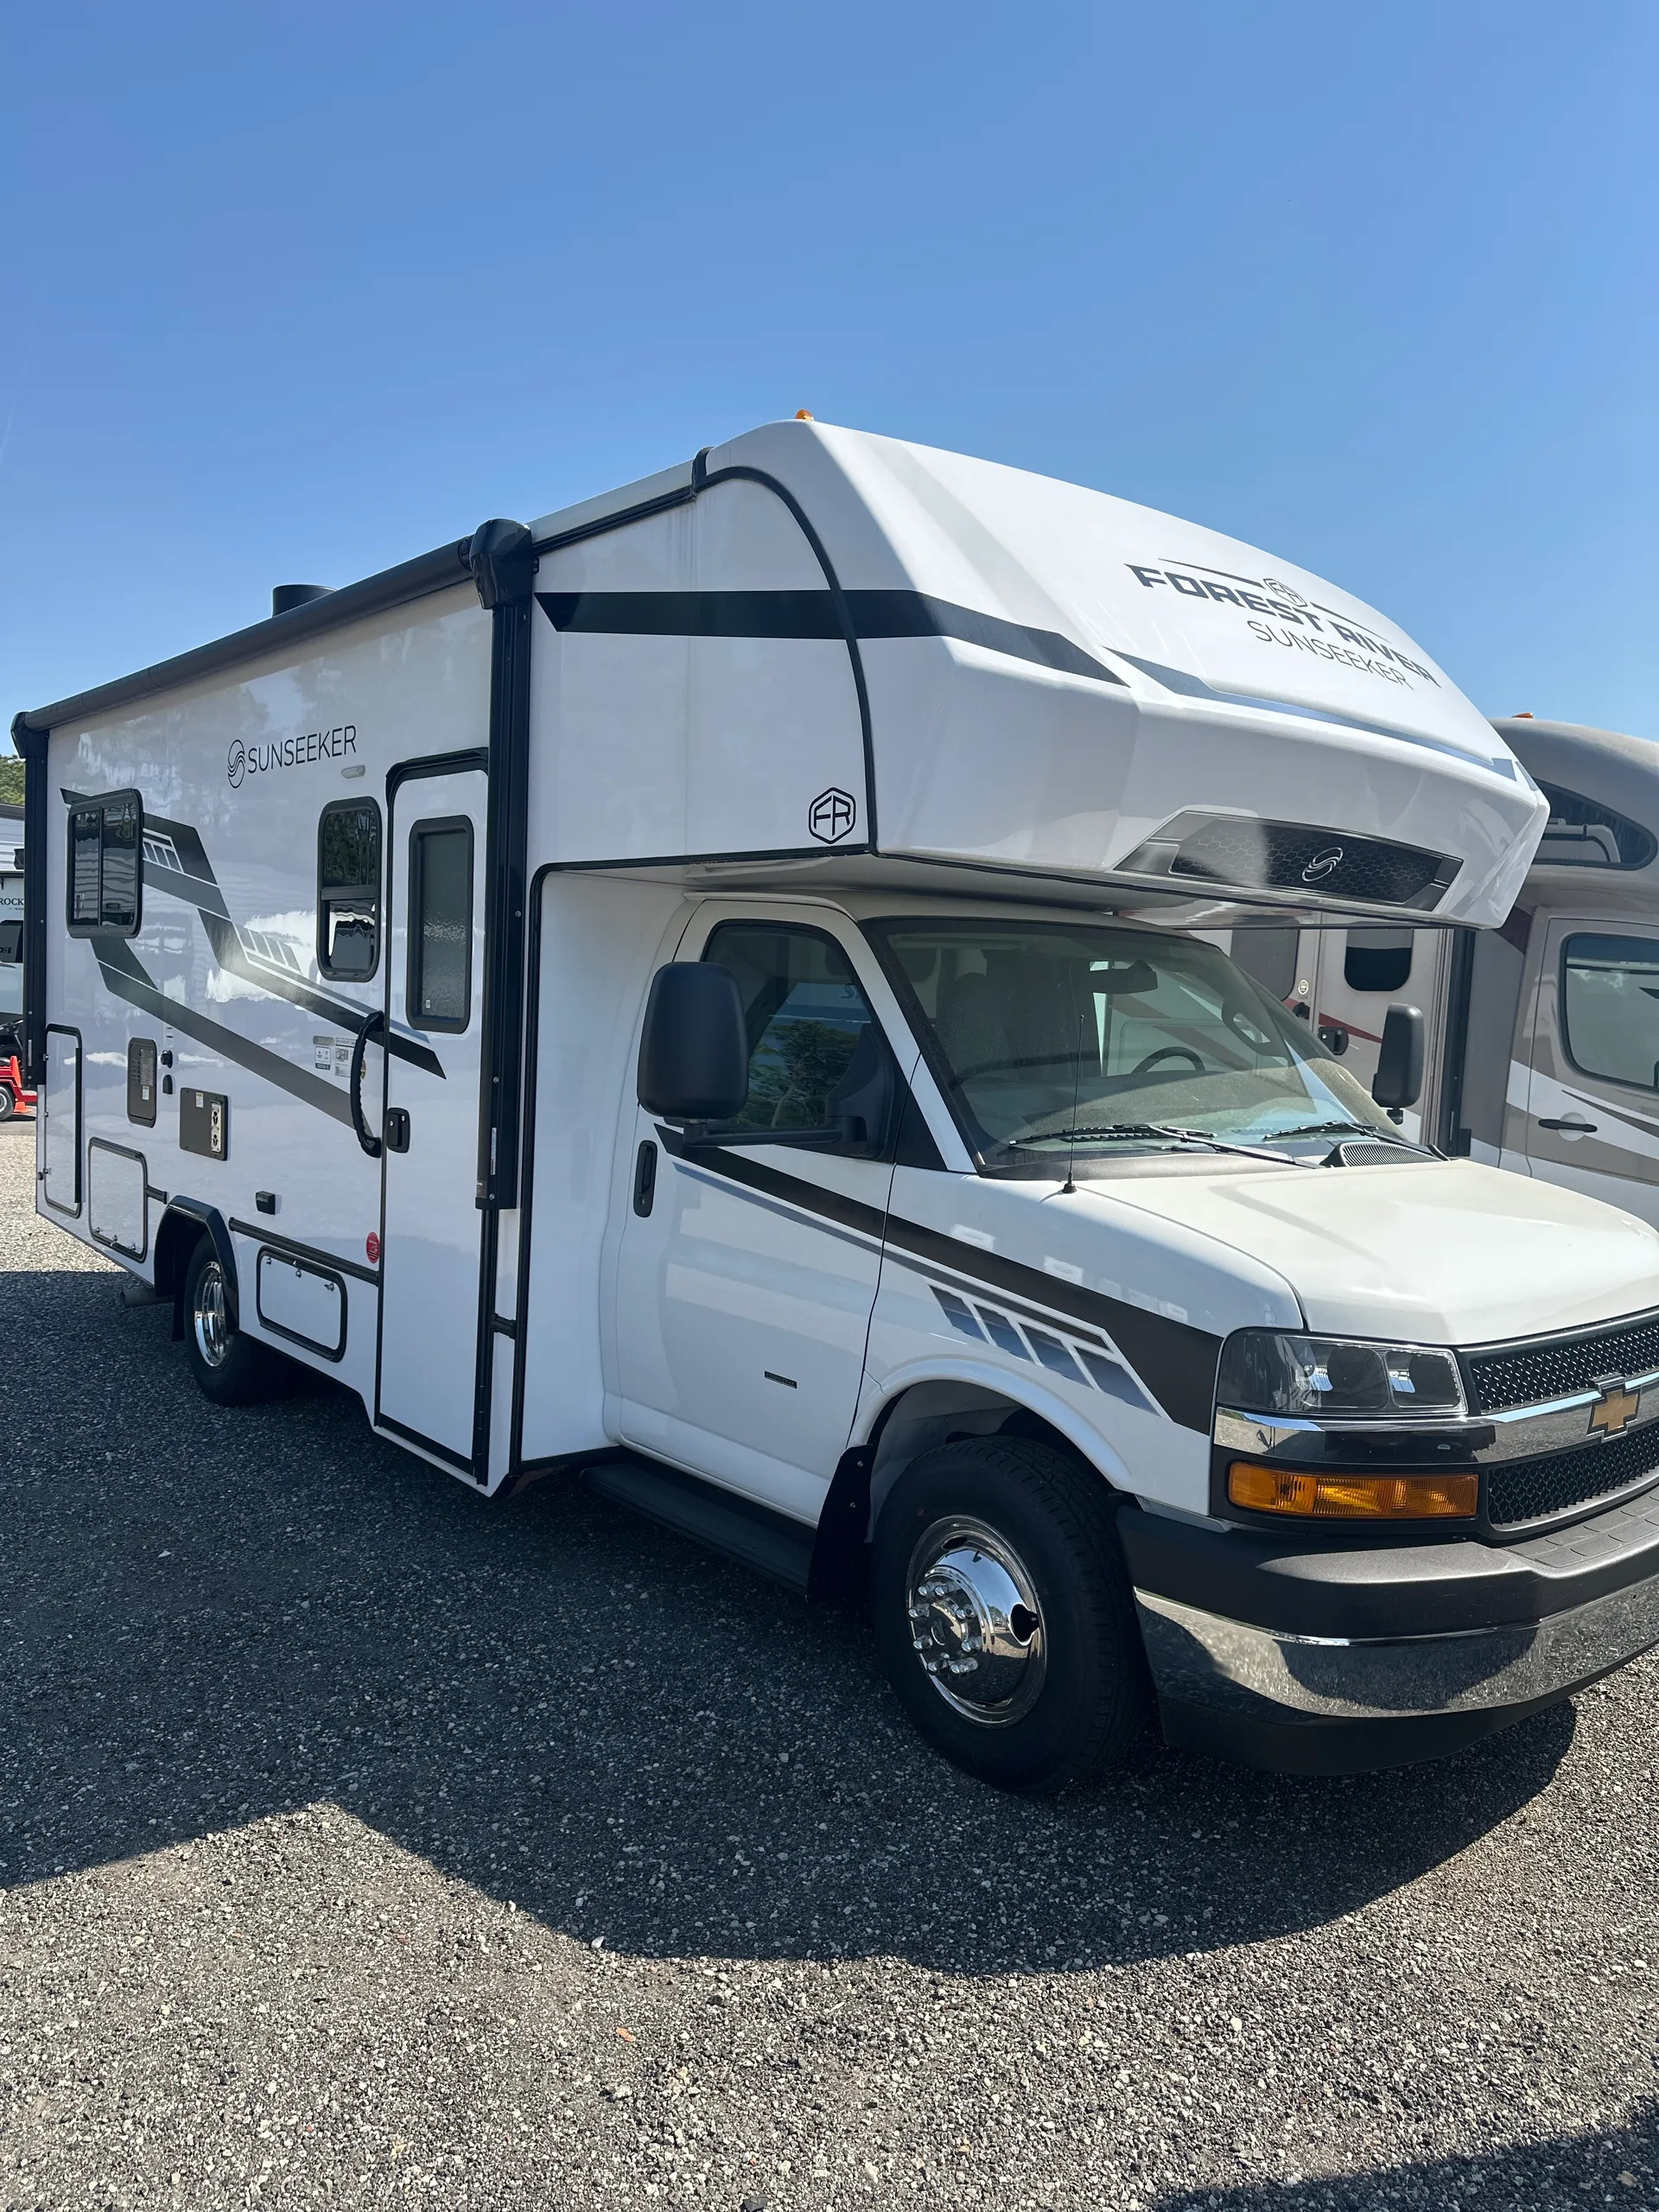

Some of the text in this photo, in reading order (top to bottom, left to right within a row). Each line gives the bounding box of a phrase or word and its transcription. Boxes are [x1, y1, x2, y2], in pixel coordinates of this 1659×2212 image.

[1123, 563, 1442, 688] FOREST RIVER
[1246, 620, 1414, 690] SUNSEEKER
[247, 724, 357, 774] SUNSEEKER
